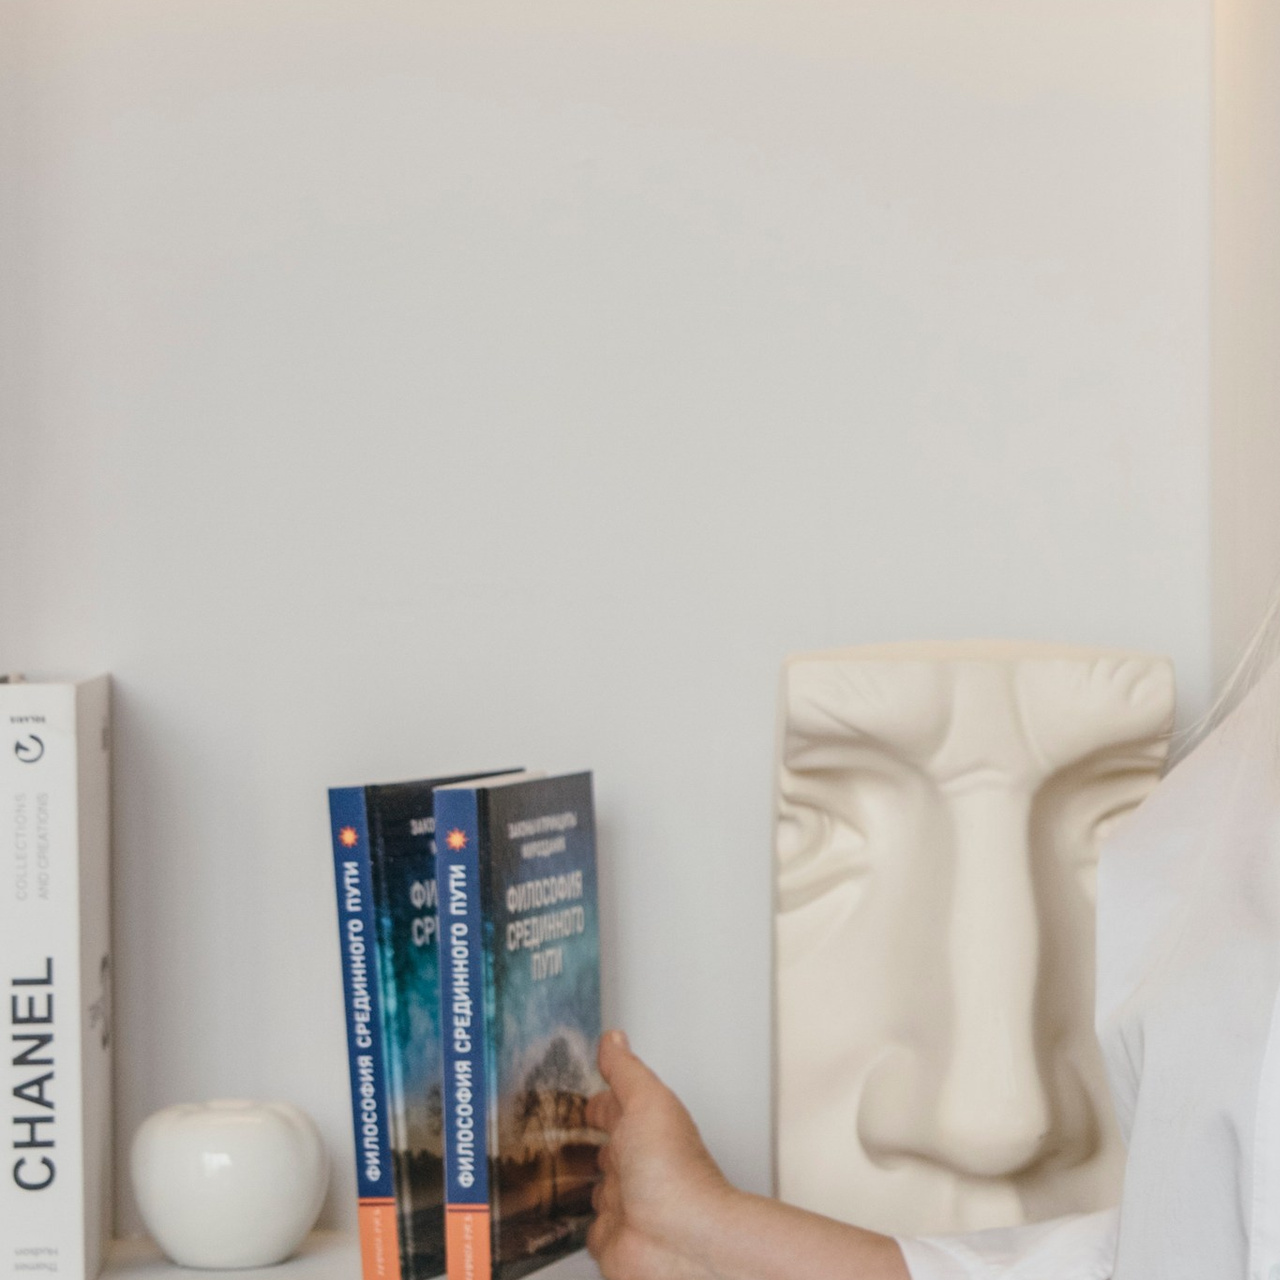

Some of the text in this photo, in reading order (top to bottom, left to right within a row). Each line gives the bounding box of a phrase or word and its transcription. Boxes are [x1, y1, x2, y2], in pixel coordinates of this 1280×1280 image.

[345, 860, 362, 914] ПУТИ
[449, 864, 467, 915] ПУТИ
[346, 917, 373, 1048] СРЕДИННОГО
[450, 921, 473, 1053] СРЕДИННОГО
[12, 957, 56, 1192] CHANEL
[356, 1052, 381, 1182] ФИЛОСОФИЯ
[453, 1058, 475, 1188] ФИЛОСОФИЯ
